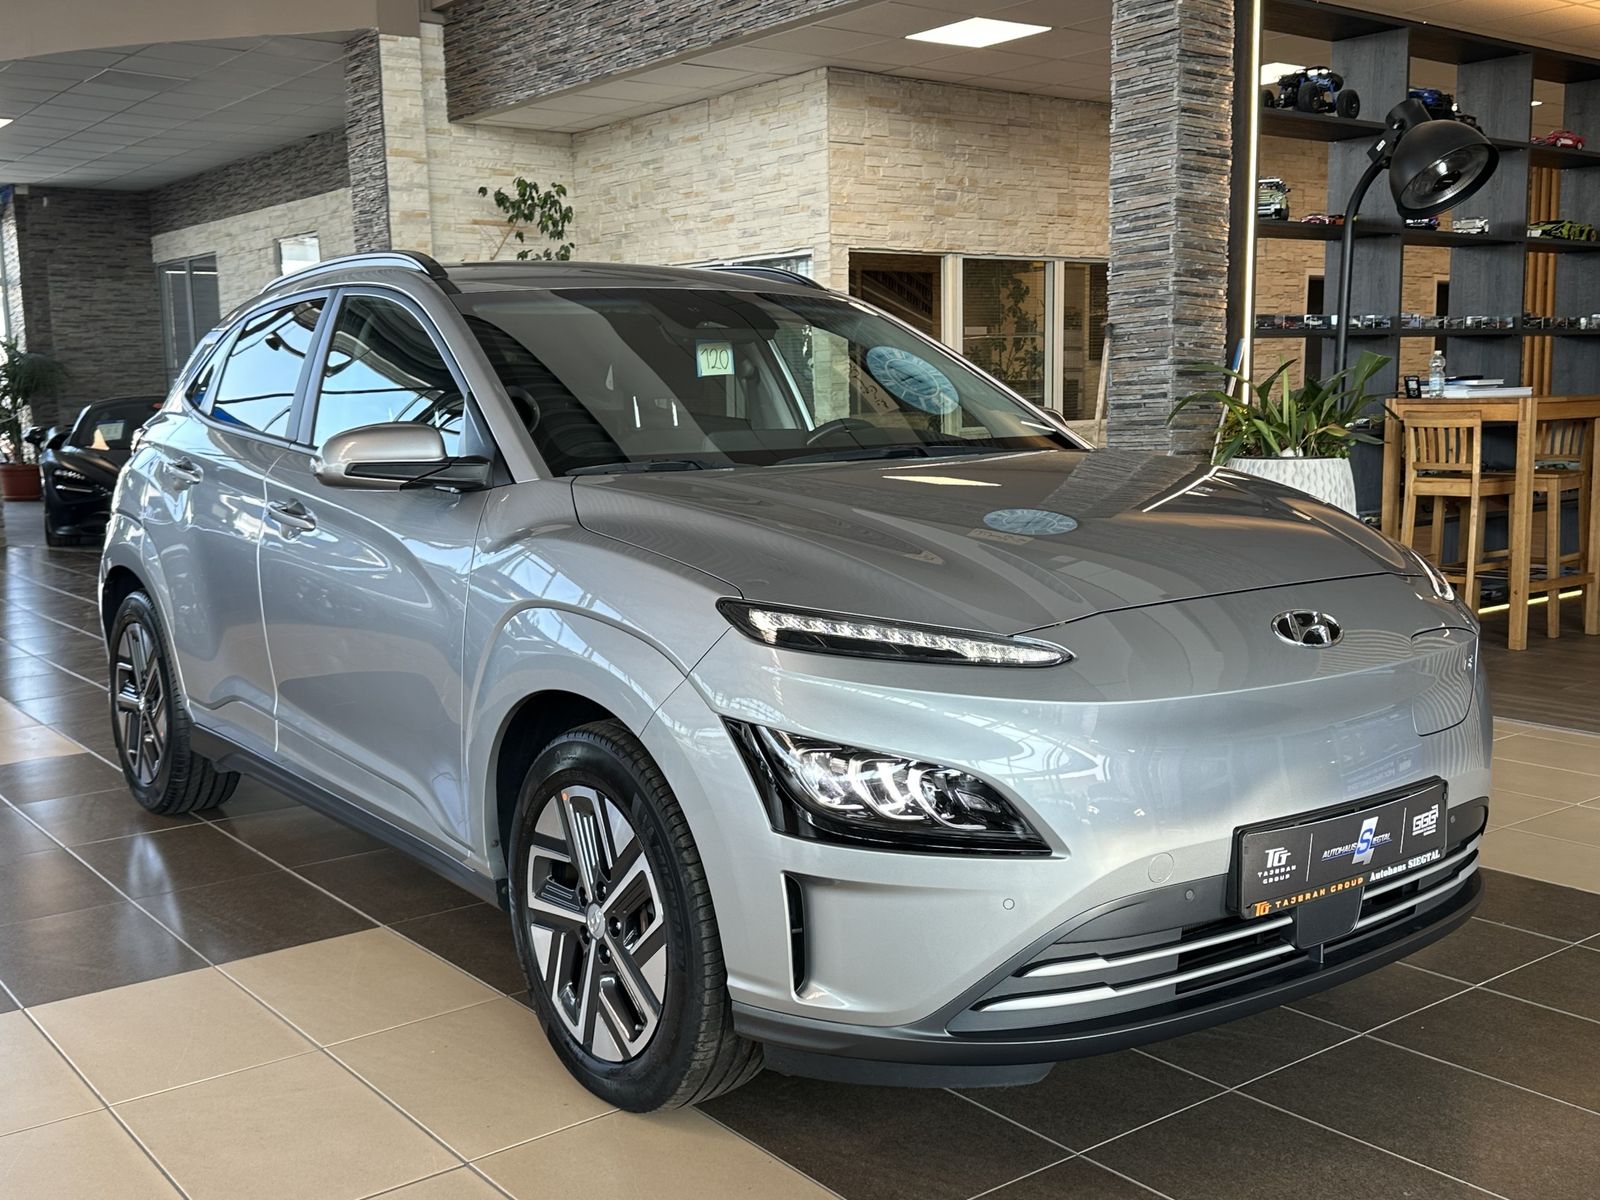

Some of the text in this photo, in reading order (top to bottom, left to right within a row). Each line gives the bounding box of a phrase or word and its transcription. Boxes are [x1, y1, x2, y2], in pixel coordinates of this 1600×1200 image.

[701, 347, 729, 370] 120
[1322, 842, 1358, 859] AUTOHAUS
[1370, 849, 1441, 882] Autohaus SIEGTAL
[1263, 873, 1290, 885] GROUP
[1330, 877, 1364, 893] GROUP
